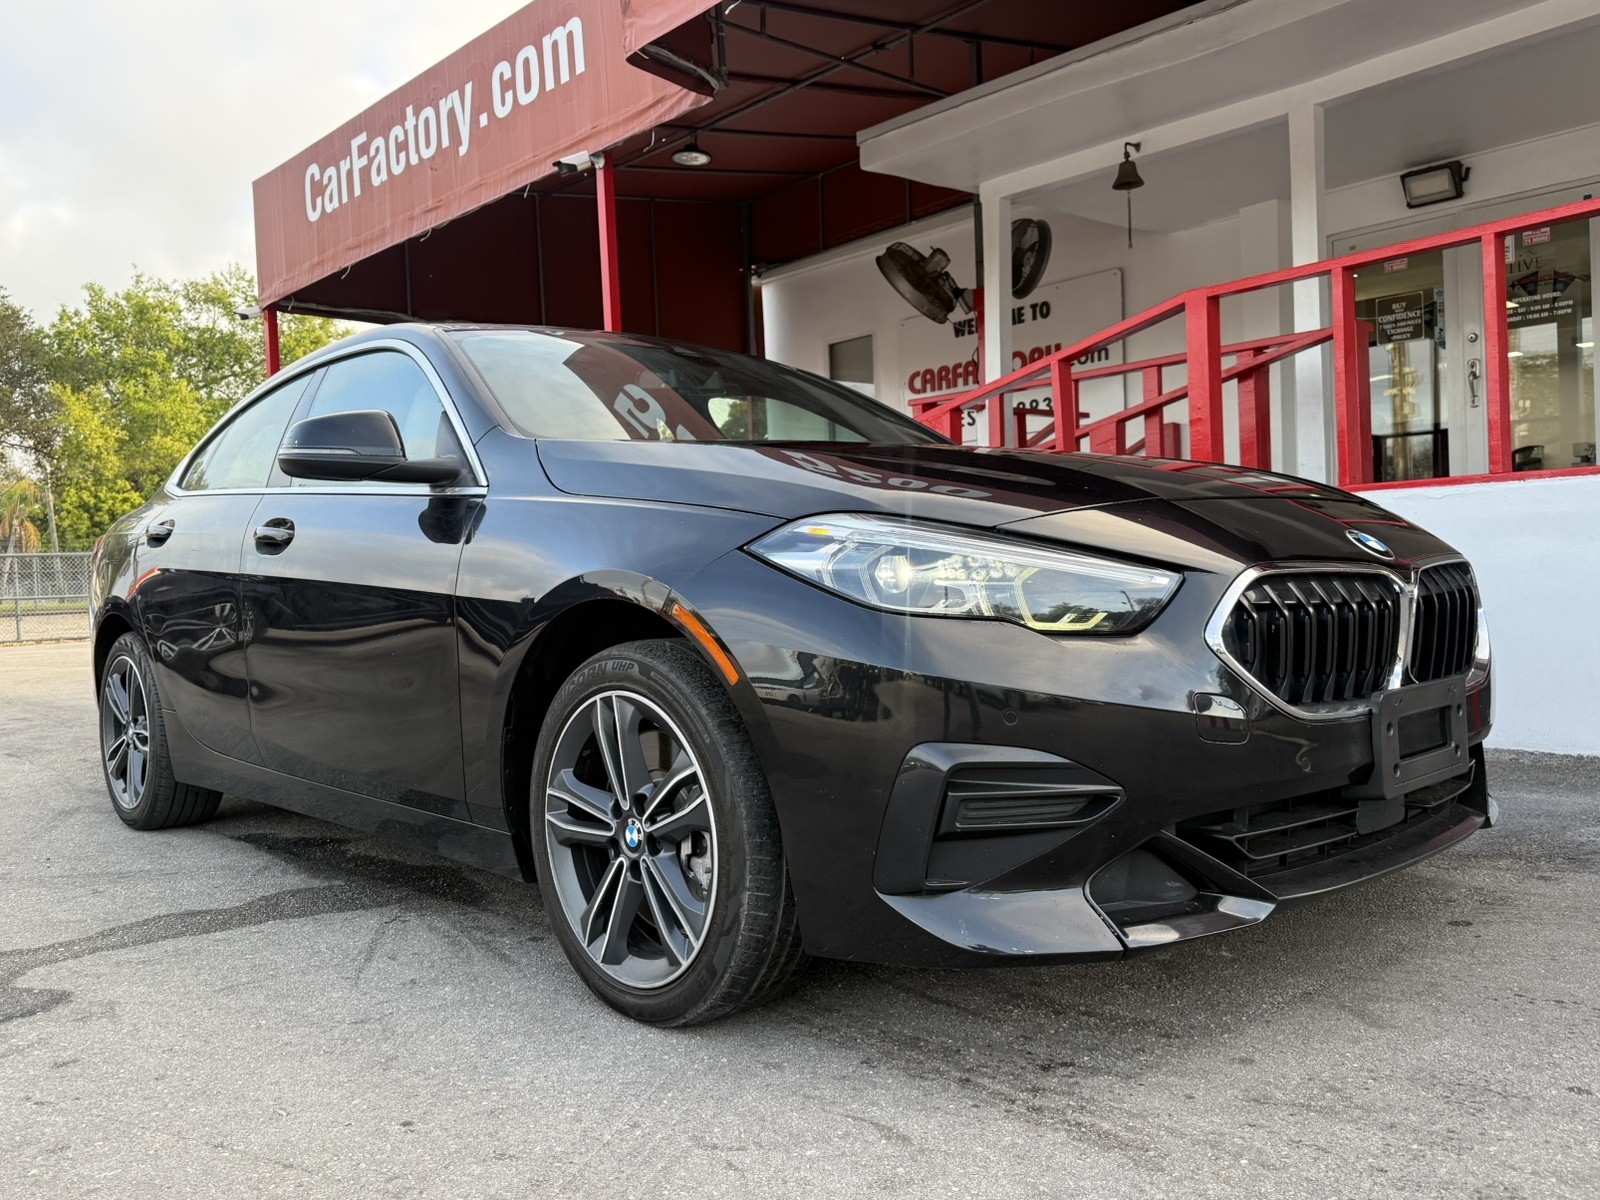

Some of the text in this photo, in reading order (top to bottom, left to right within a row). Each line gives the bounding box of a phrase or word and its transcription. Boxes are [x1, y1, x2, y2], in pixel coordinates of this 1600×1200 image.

[1030, 301, 1051, 321] TO
[1379, 310, 1421, 323] CONFIDENCE
[611, 660, 635, 673] UHP
